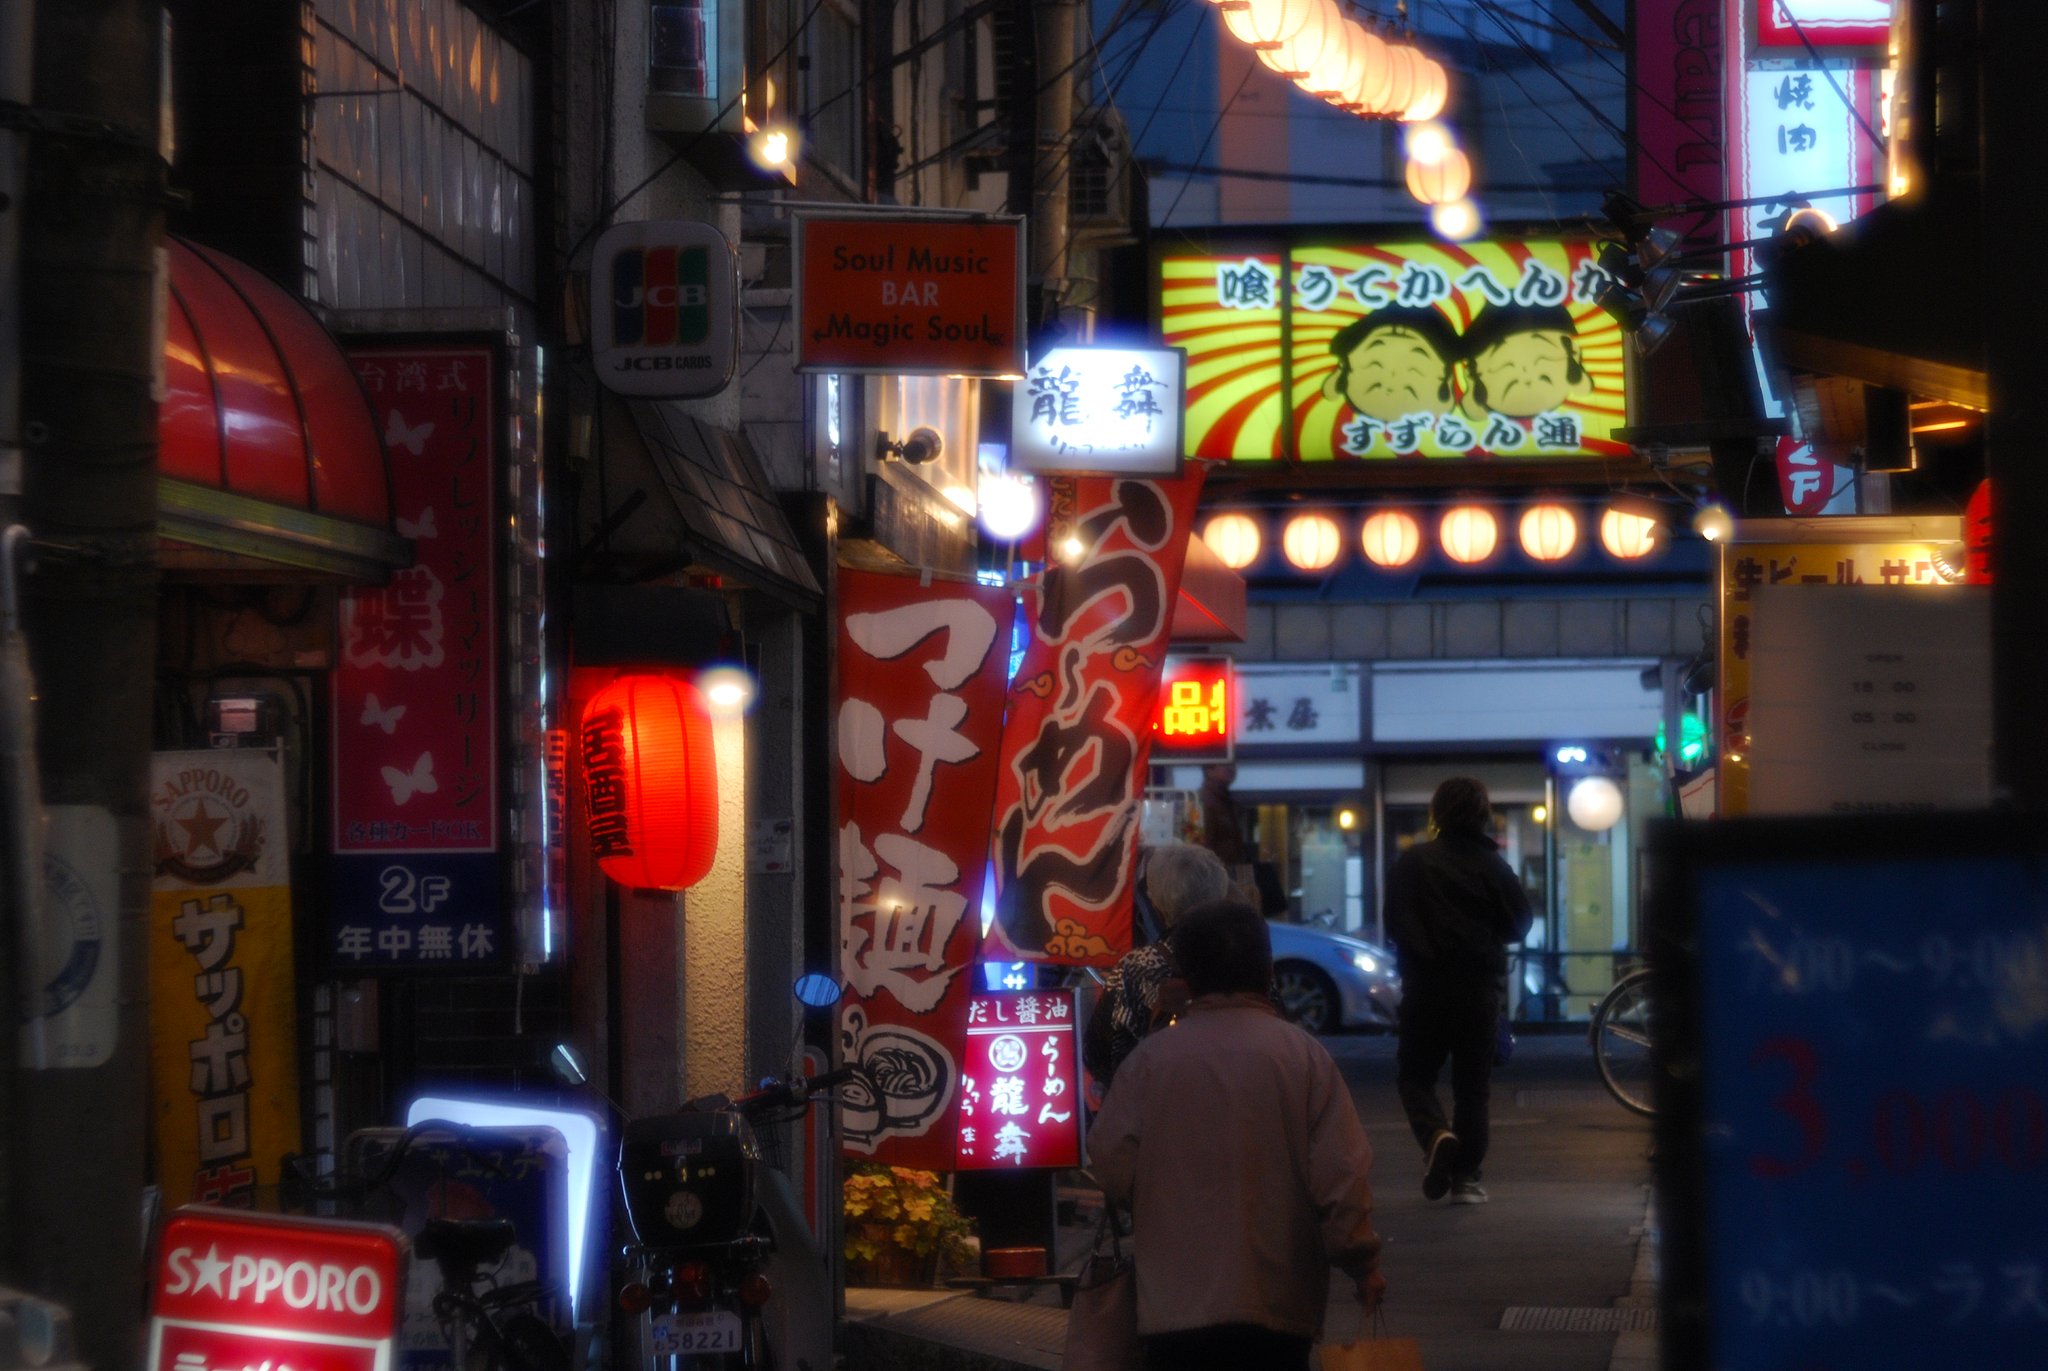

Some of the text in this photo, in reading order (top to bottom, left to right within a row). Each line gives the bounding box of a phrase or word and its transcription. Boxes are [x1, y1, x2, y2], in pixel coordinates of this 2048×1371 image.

[833, 245, 990, 274] Soul Music
[614, 284, 706, 308] JCB
[881, 280, 939, 308] BAR
[827, 312, 988, 347] Magic Soul
[360, 360, 467, 392] 台湾式
[614, 355, 712, 371] JCB CARDS
[1343, 412, 1582, 453] すずらん通
[346, 820, 483, 843] 各種カードOK
[378, 865, 451, 915] 2F
[336, 923, 494, 961] 年中無休
[968, 997, 1069, 1025] だし醤油
[1037, 1035, 1071, 1125] らーめん
[668, 1330, 735, 1350] 58221
